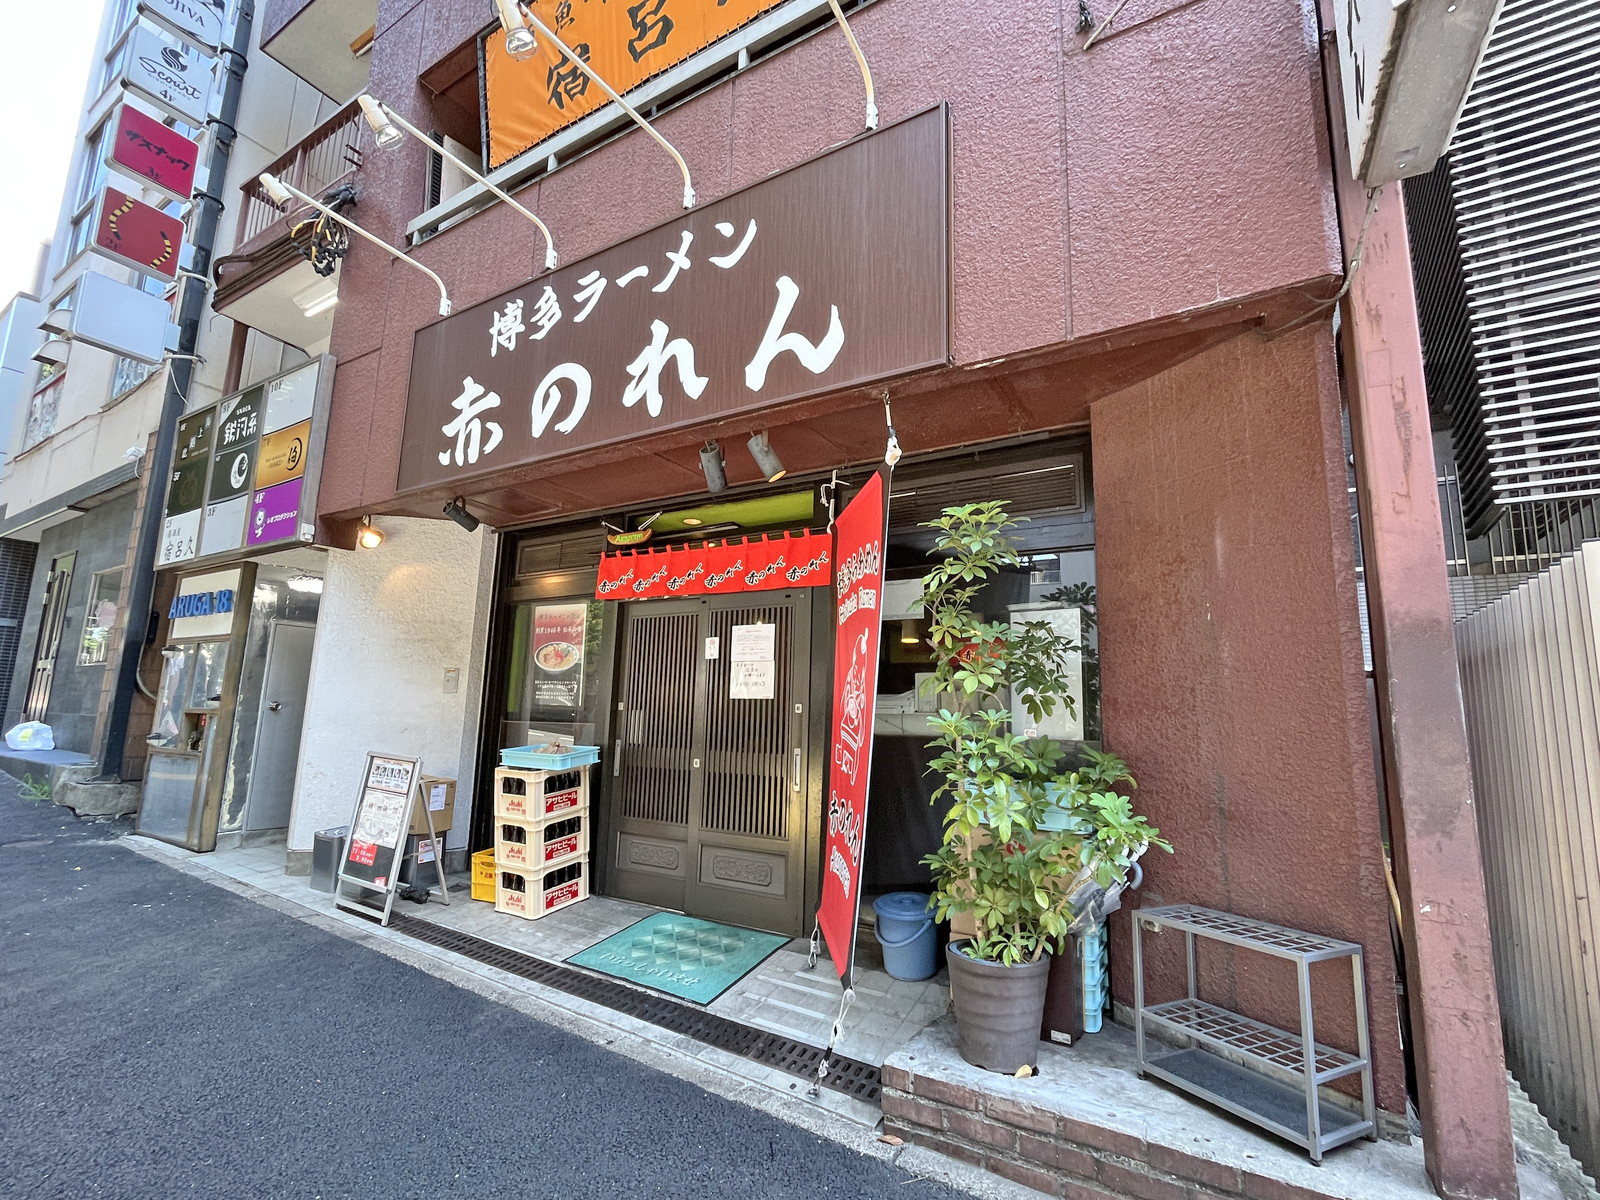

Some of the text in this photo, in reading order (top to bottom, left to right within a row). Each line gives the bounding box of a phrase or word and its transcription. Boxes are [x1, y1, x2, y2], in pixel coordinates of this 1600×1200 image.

[163, 0, 205, 28] JIVA
[160, 89, 176, 102] 4F
[489, 218, 757, 357] 博多ラーメン
[438, 276, 845, 467] 赤のれん
[270, 378, 285, 393] 10F
[254, 491, 265, 504] 4F
[598, 551, 829, 594] 赤のれん 赤のれん 赤のれん 赤のれん 赤のれん 赤のれん
[168, 591, 214, 619] ARUGA
[546, 790, 578, 806] アサヒビール
[829, 790, 861, 868] 赤のれん
[545, 836, 577, 854] アサヒビール
[546, 883, 578, 902] アサヒビール
